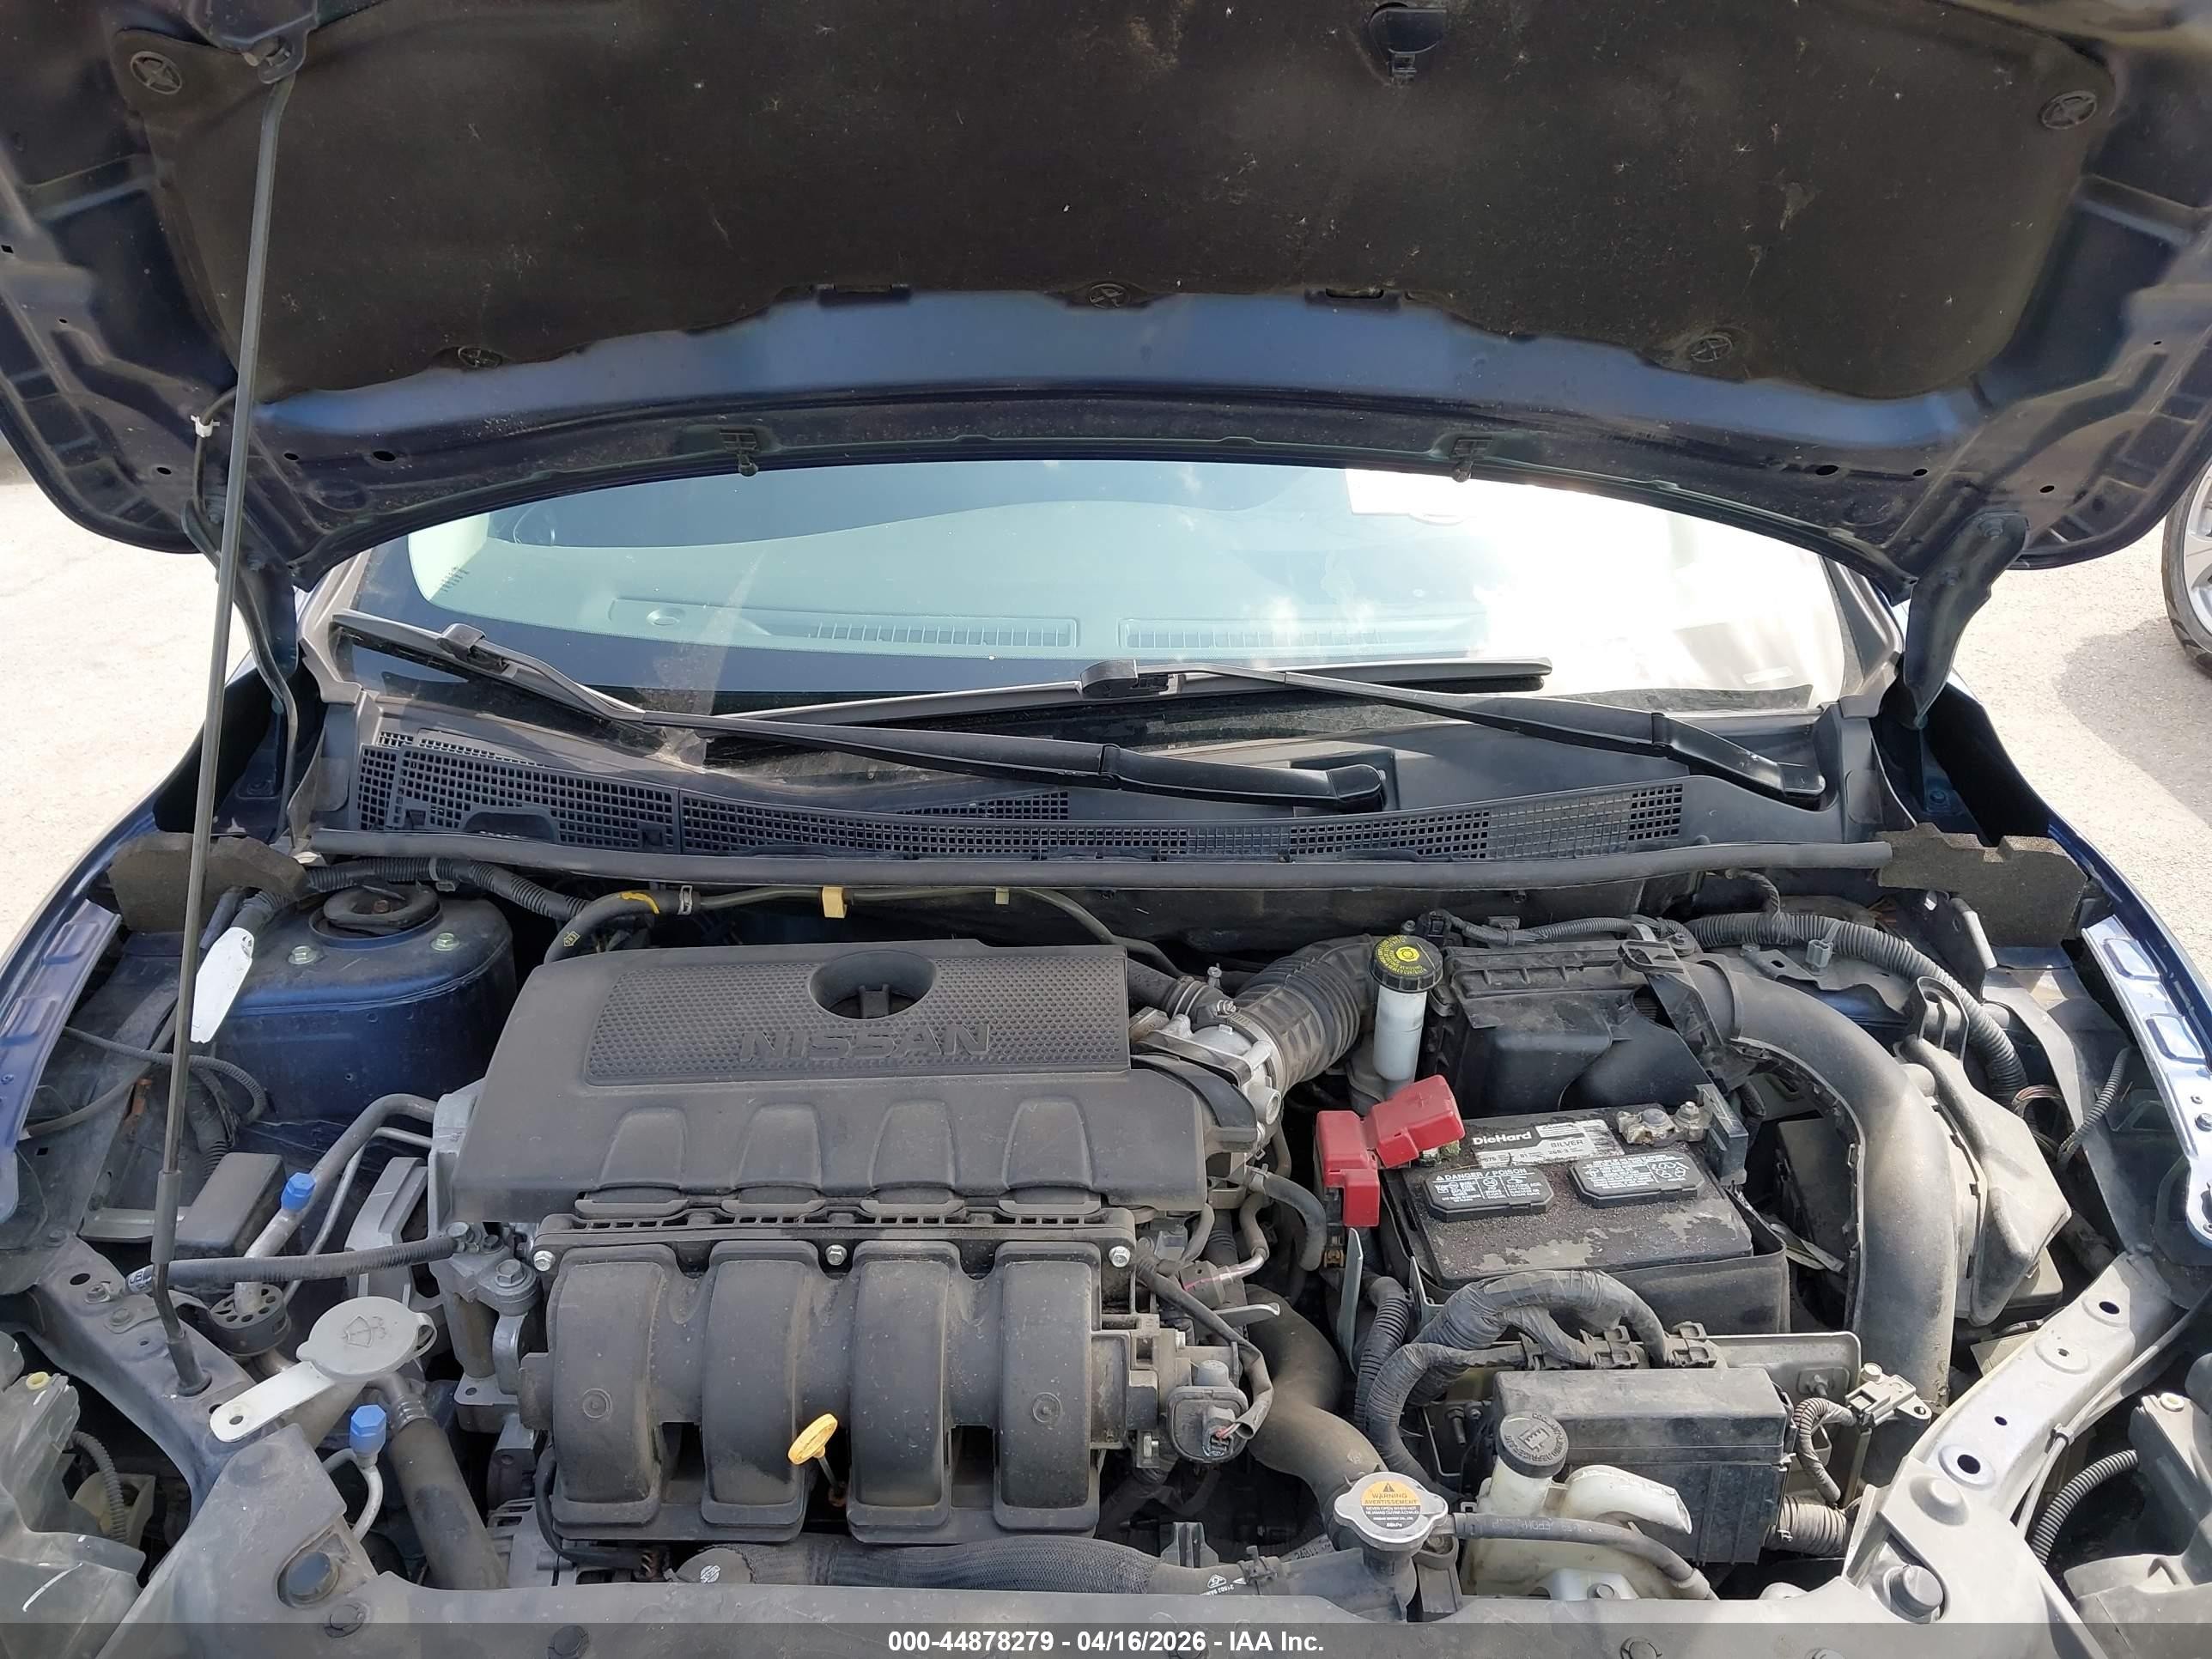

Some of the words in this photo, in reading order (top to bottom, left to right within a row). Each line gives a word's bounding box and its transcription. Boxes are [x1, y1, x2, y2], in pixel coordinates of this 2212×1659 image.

[738, 1024, 990, 1062] NISSAN
[1472, 1131, 1532, 1146] DieHard
[1550, 1139, 1584, 1148] SILVER
[1443, 1171, 1484, 1181] DANGER
[1492, 1168, 1528, 1176] POISON
